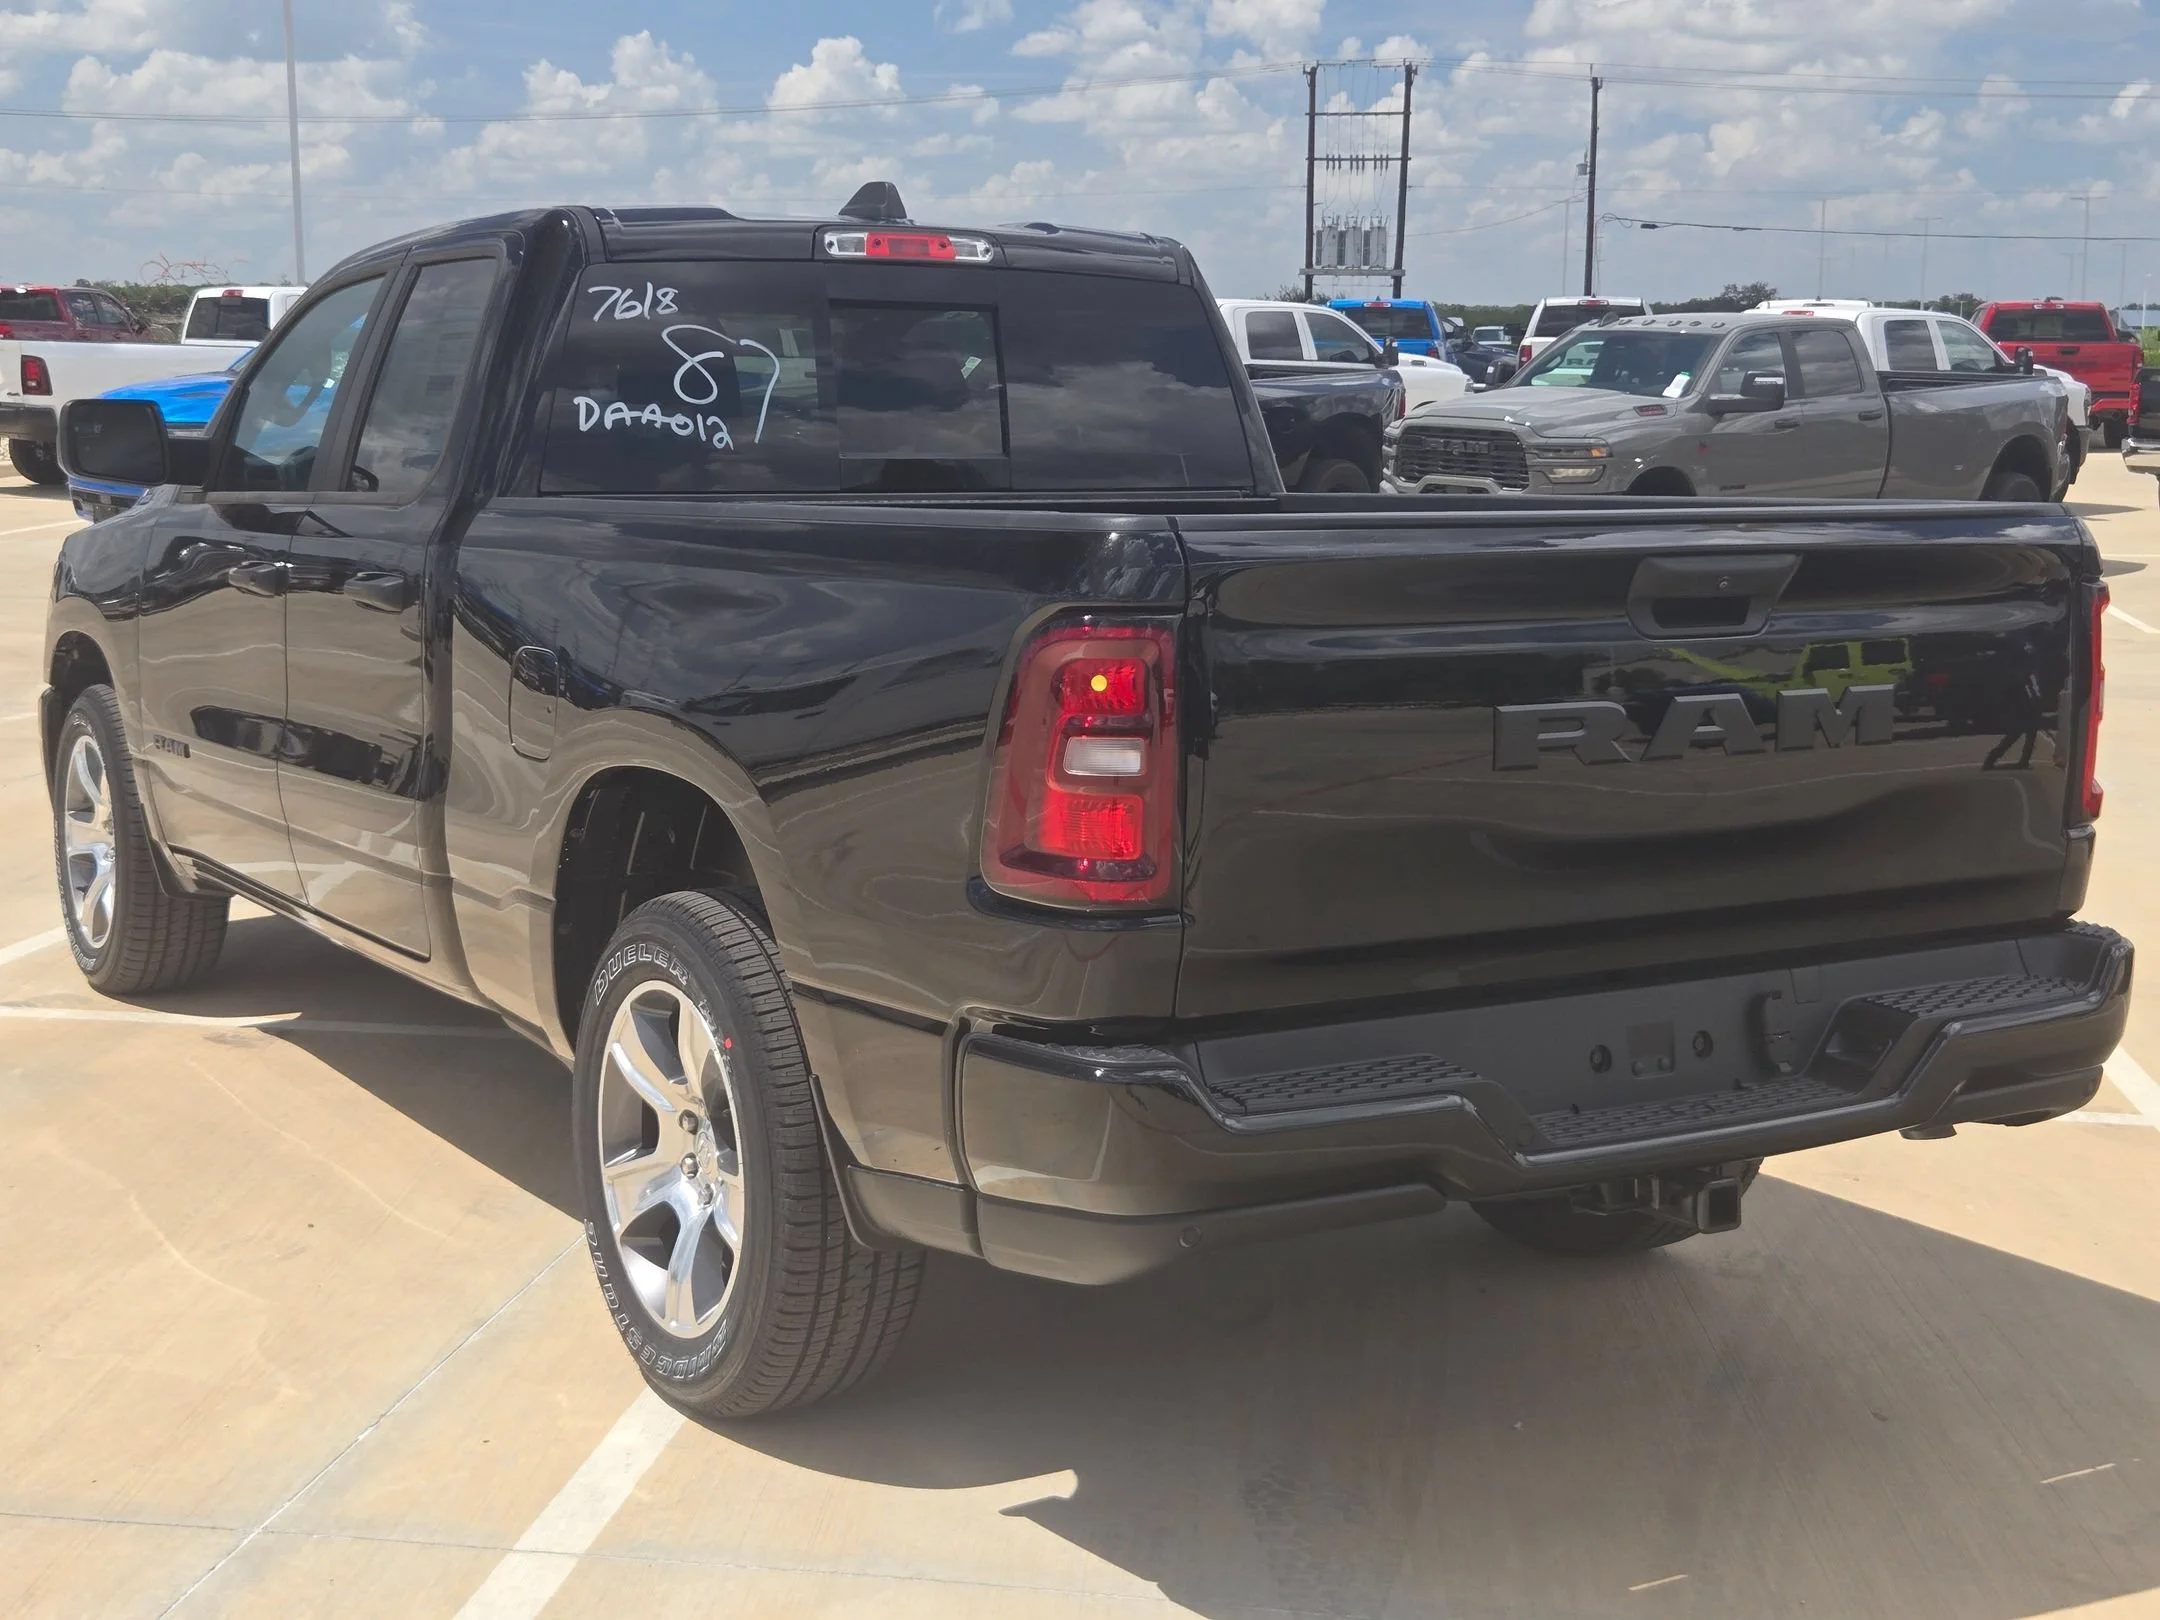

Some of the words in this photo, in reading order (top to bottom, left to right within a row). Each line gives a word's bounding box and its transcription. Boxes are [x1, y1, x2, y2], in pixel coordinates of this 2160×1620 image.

[588, 282, 678, 322] 7618
[1493, 683, 1895, 771] RAM
[594, 943, 690, 1006] DUELER
